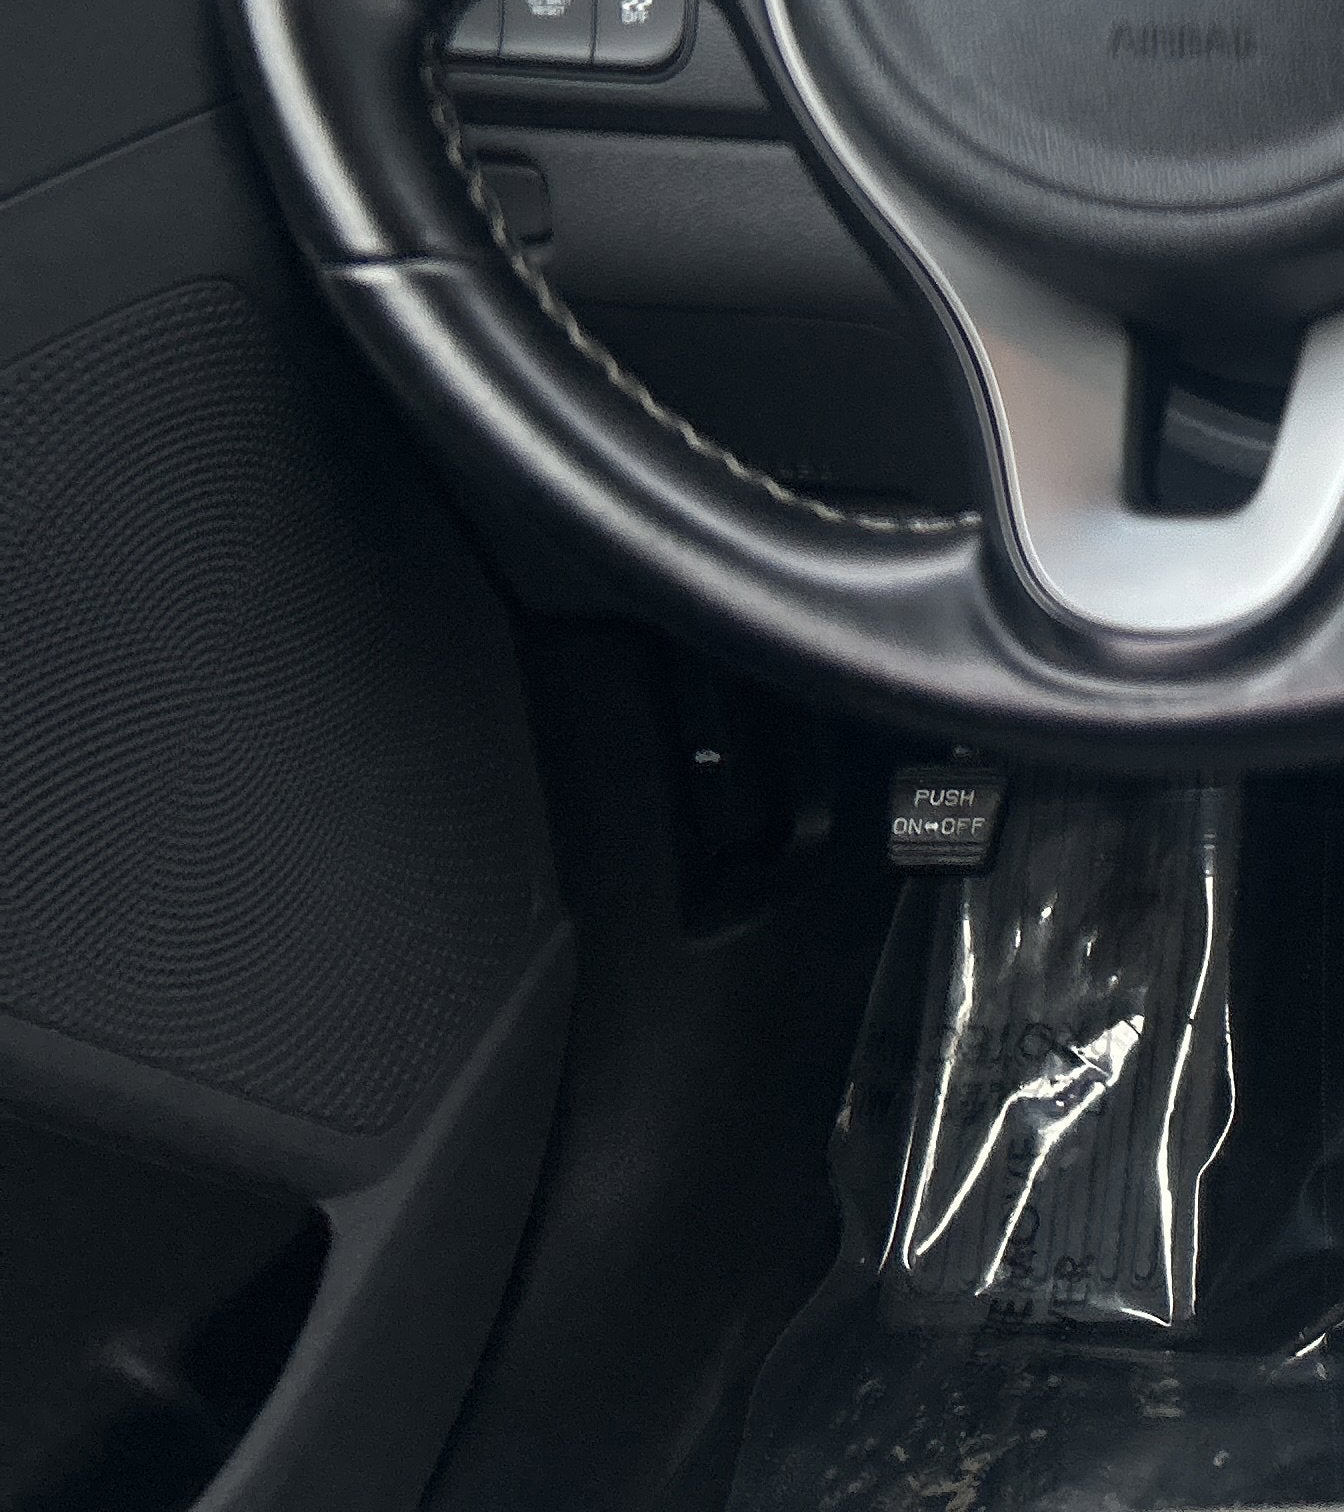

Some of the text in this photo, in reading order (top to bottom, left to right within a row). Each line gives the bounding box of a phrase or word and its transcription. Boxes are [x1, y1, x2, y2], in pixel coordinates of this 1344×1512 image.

[913, 789, 977, 808] PUSH
[892, 817, 986, 836] ON OFF
